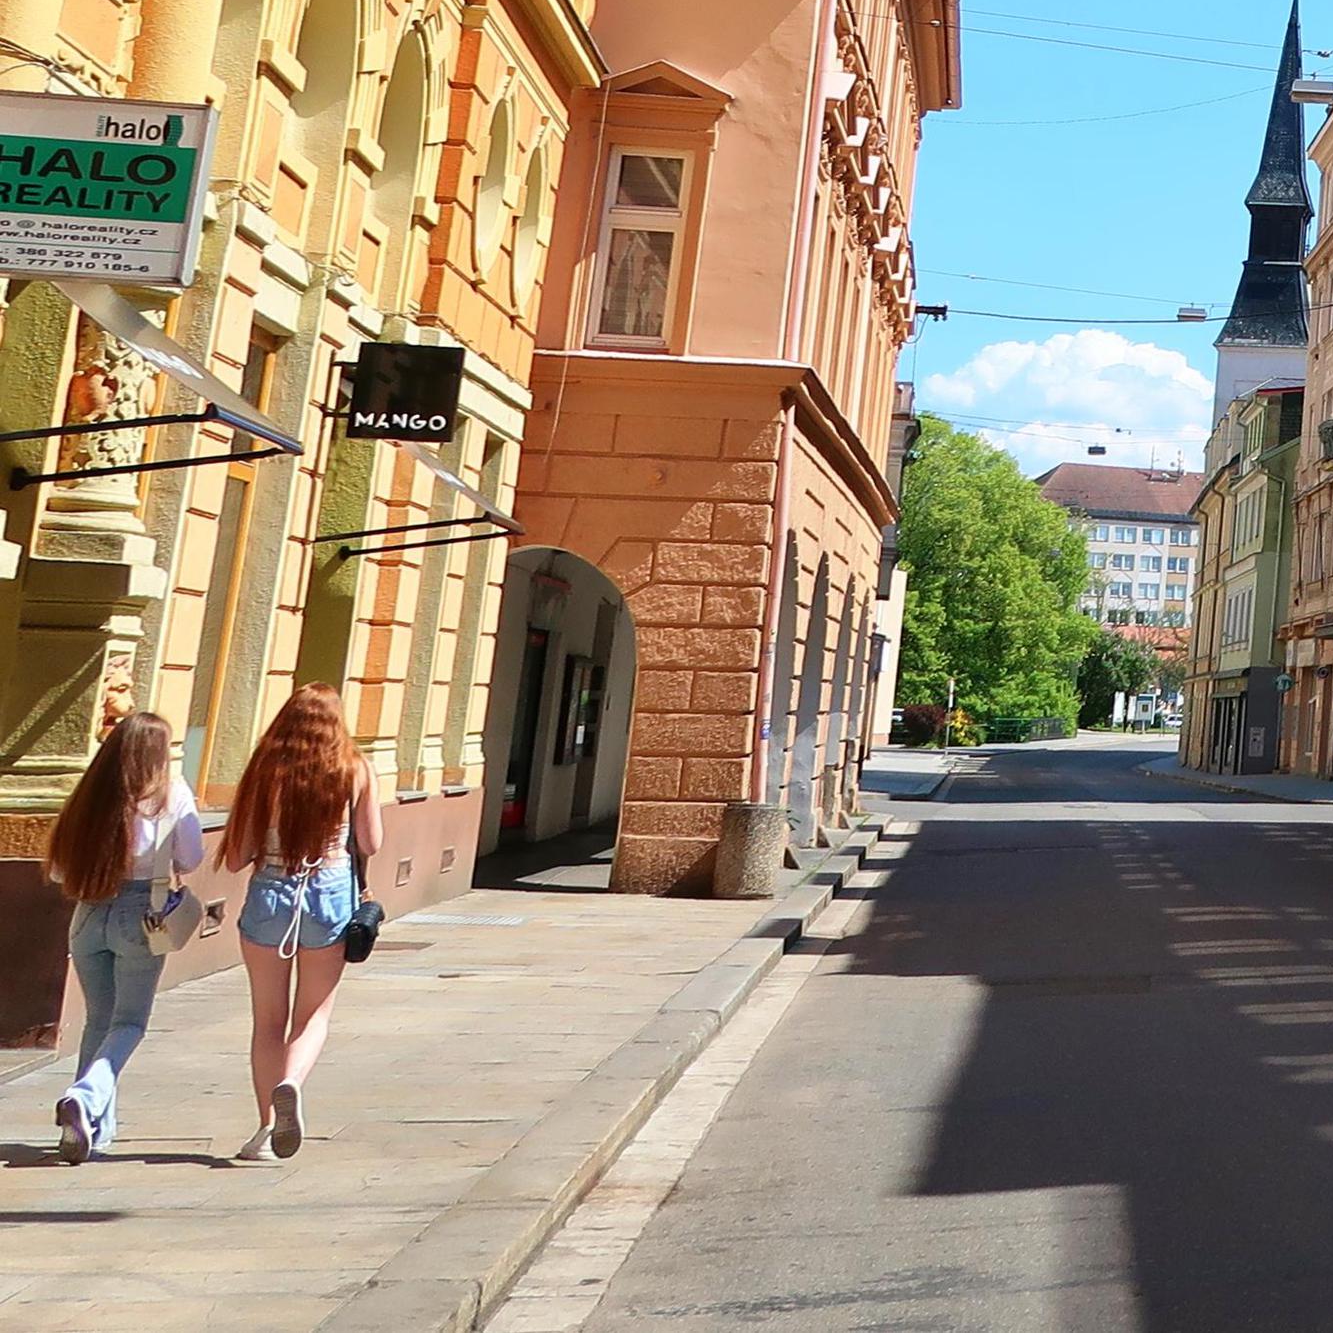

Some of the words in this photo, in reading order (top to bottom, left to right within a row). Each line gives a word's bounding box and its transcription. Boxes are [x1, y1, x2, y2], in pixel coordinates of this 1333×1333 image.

[104, 116, 161, 141] halo
[0, 144, 177, 186] HALO
[41, 221, 159, 236] haloreality.cz
[354, 412, 447, 431] MANGO
